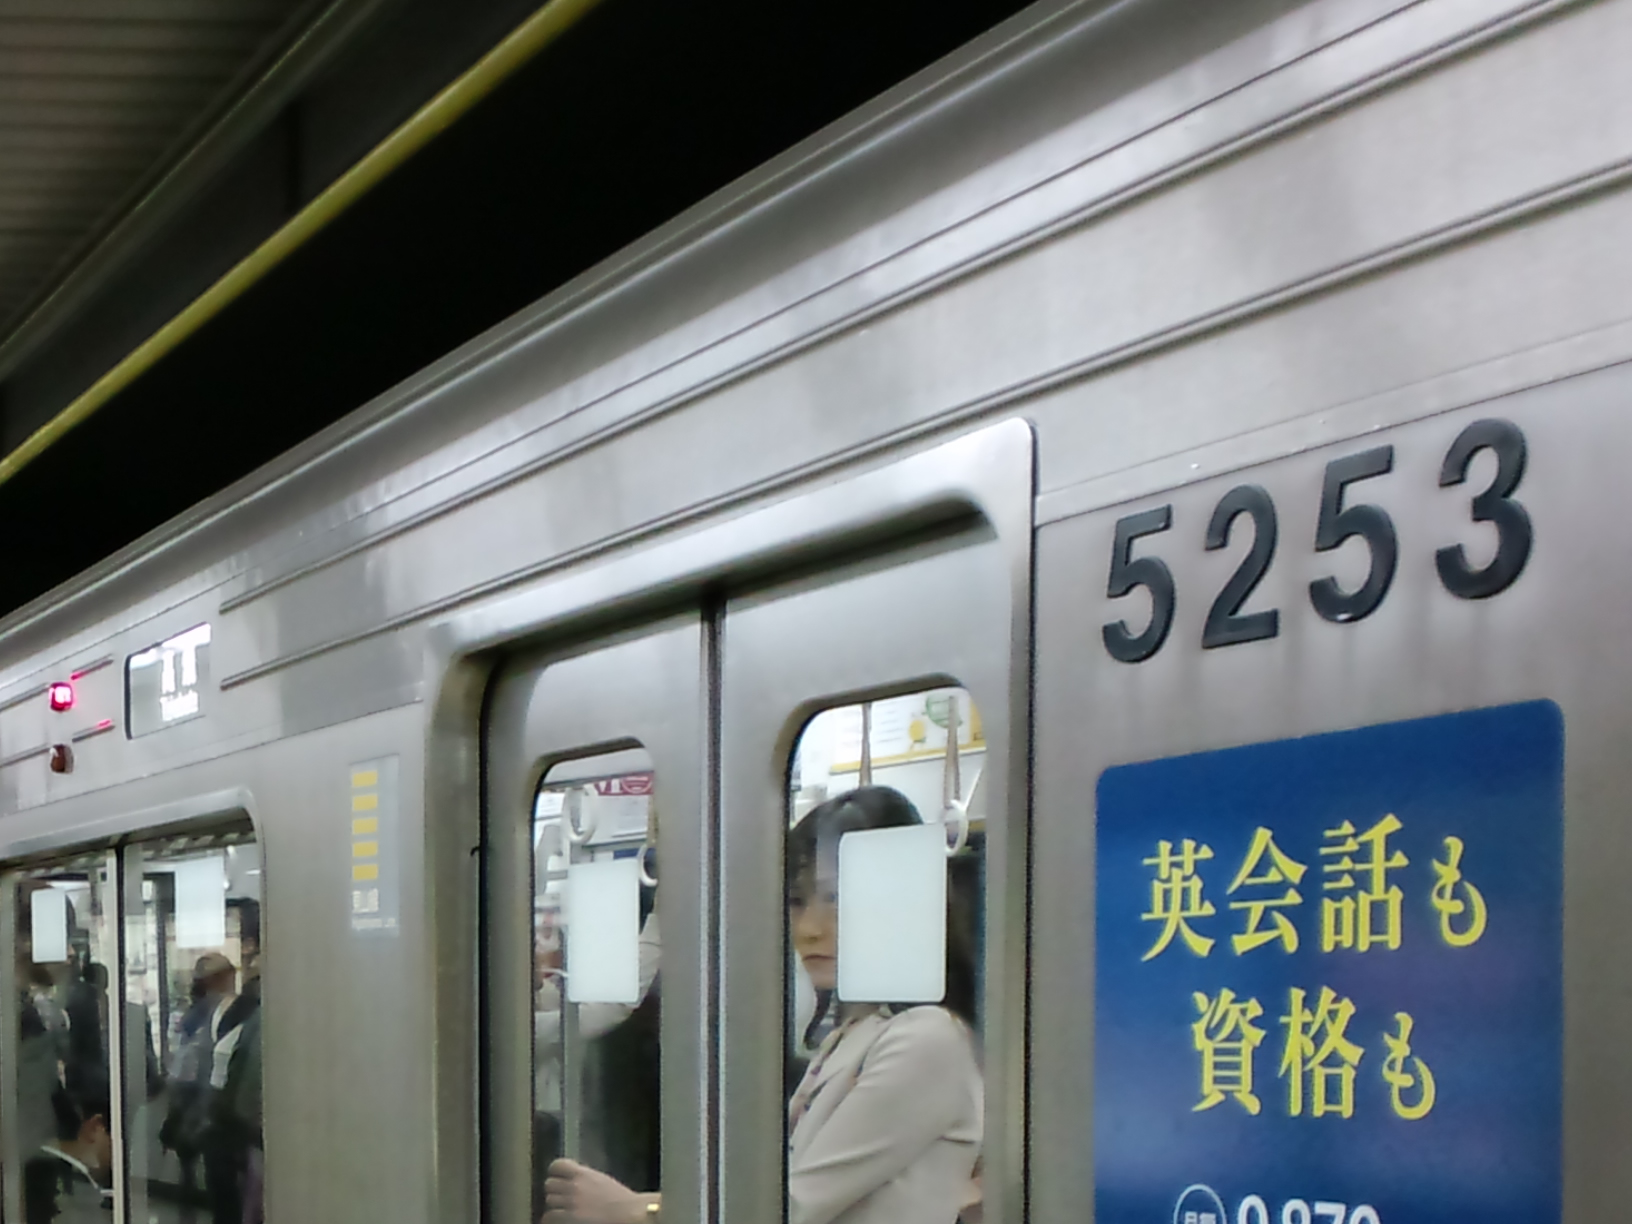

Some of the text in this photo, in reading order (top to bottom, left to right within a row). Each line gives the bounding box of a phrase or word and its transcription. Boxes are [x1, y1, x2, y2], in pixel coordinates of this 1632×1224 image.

[1101, 417, 1533, 663] 5253
[1140, 813, 1488, 963] 英会話も
[1191, 985, 1437, 1120] 資格も
